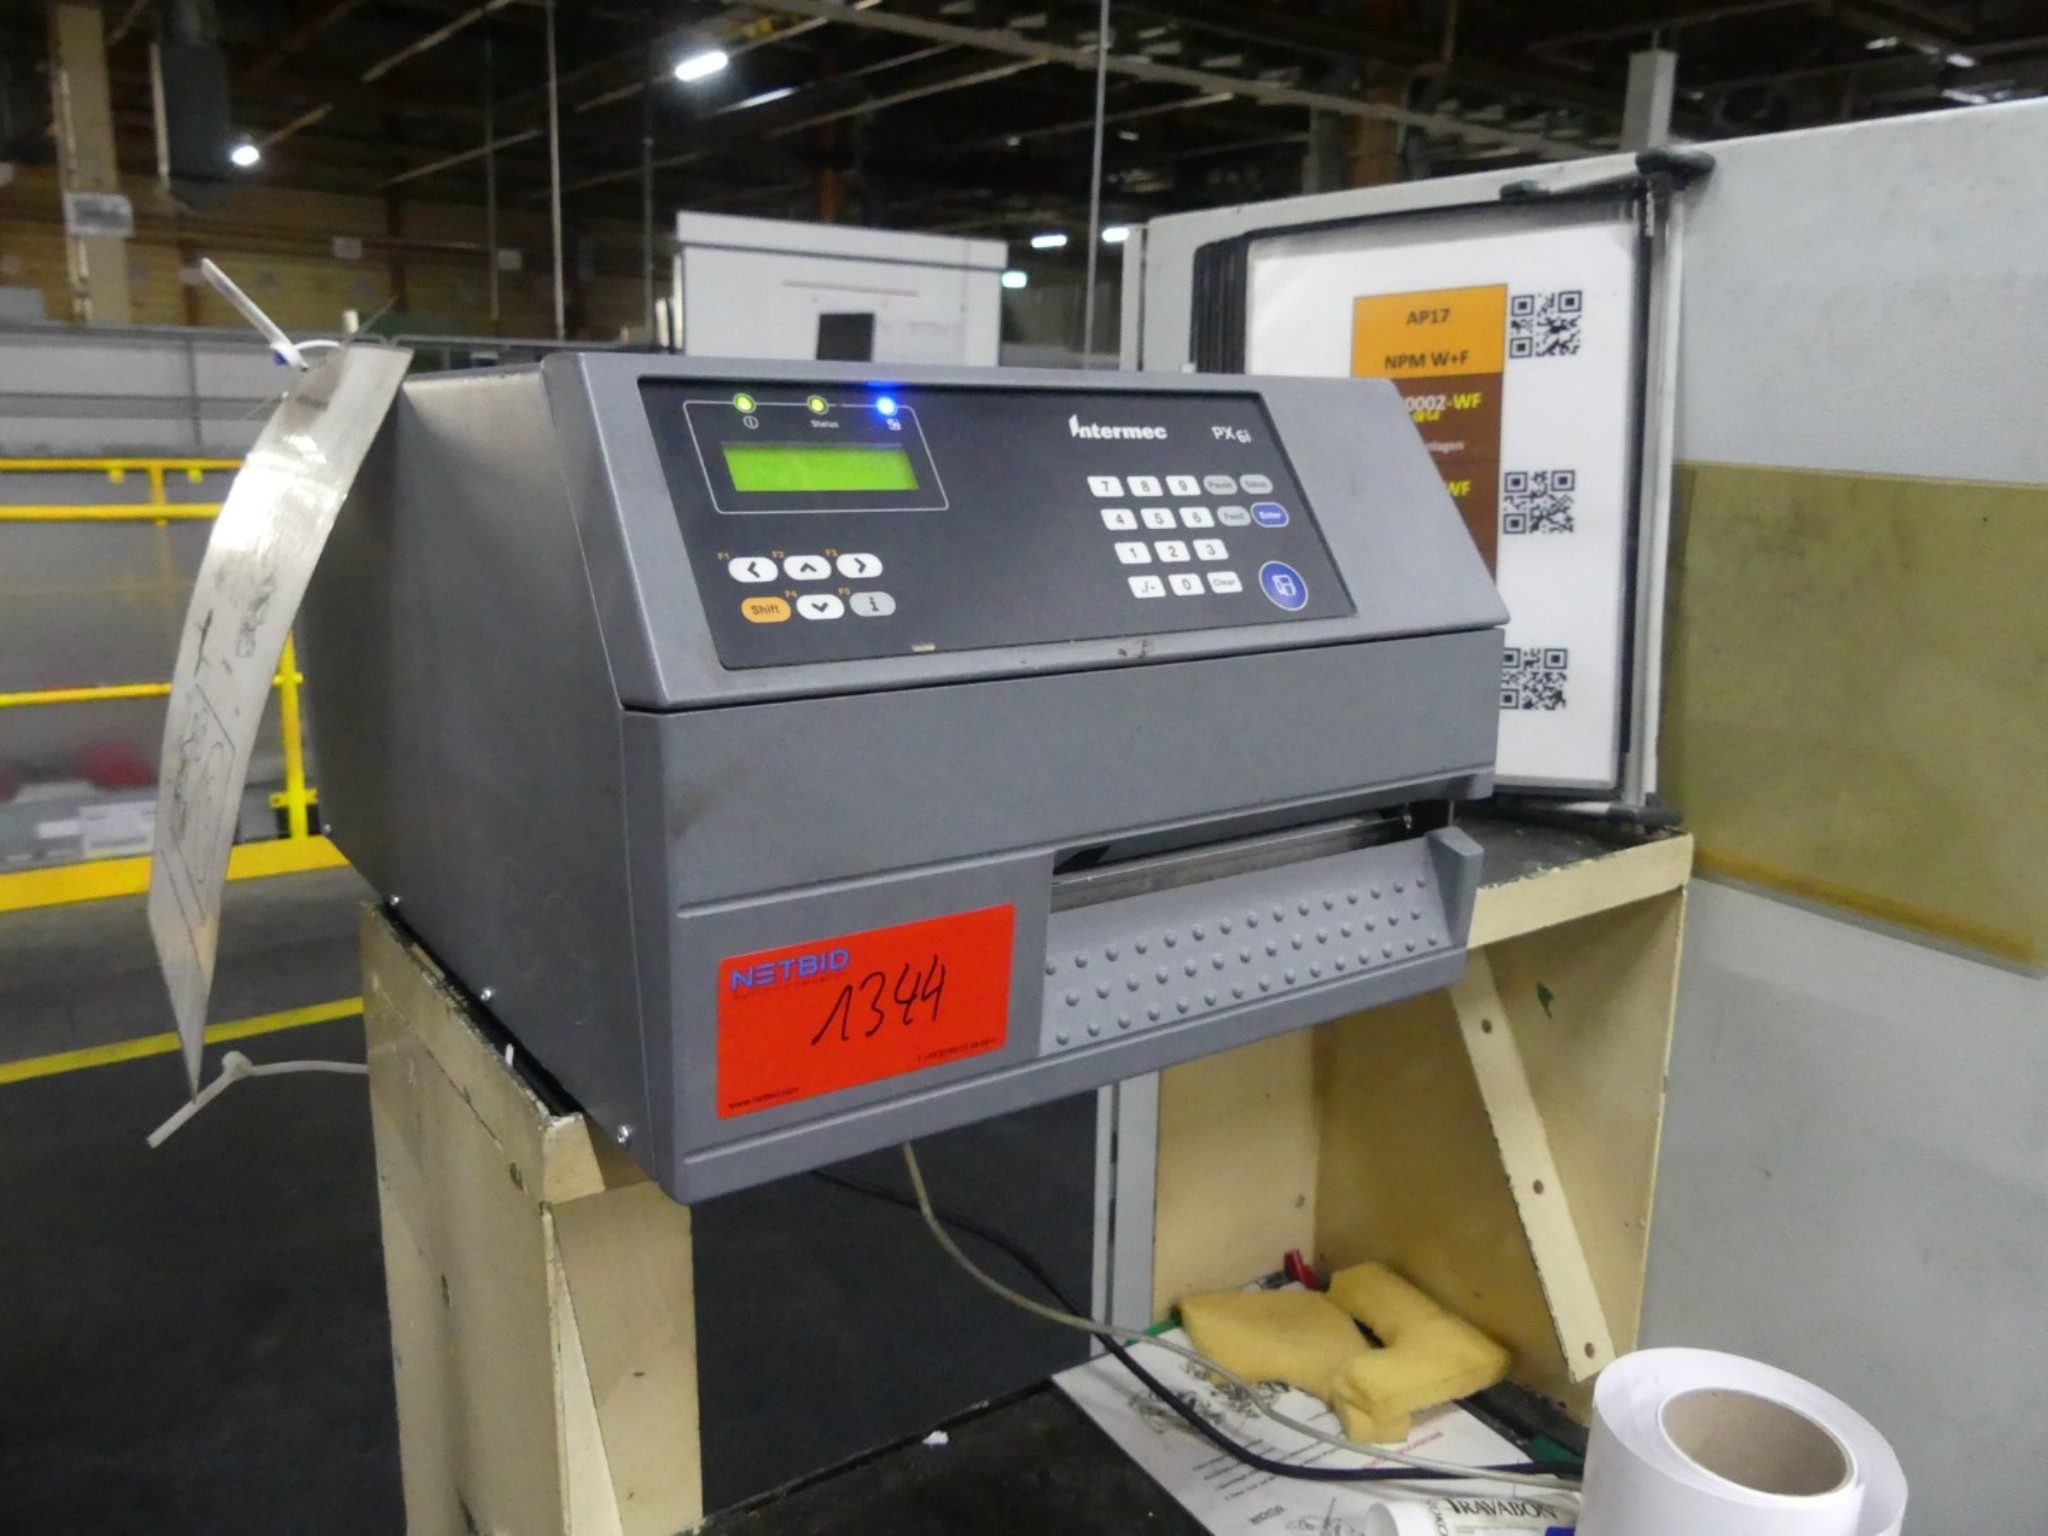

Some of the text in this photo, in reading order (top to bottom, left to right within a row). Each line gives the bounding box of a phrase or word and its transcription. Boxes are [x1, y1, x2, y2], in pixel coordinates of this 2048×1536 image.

[1407, 308, 1450, 326] AP17
[1385, 350, 1469, 370] NPM W+F
[810, 419, 840, 430] Status
[1069, 414, 1252, 443] Intermec PX6i
[1101, 481, 1110, 492] 7
[1140, 480, 1150, 492] 8
[1178, 480, 1189, 491] 9
[1115, 514, 1125, 525] 4
[1154, 513, 1164, 525] 5
[1192, 512, 1202, 523] 6
[718, 549, 838, 560] F1 F2 F3
[1168, 546, 1178, 557] 2
[1206, 545, 1216, 556] 3
[1181, 578, 1192, 591] 0
[1212, 577, 1236, 587] Clear
[785, 587, 850, 598] F4 F5
[750, 603, 781, 615] Shift
[730, 949, 850, 990] NETBID
[810, 954, 946, 1045] 1344
[1446, 1499, 1557, 1519] TRAVABON
